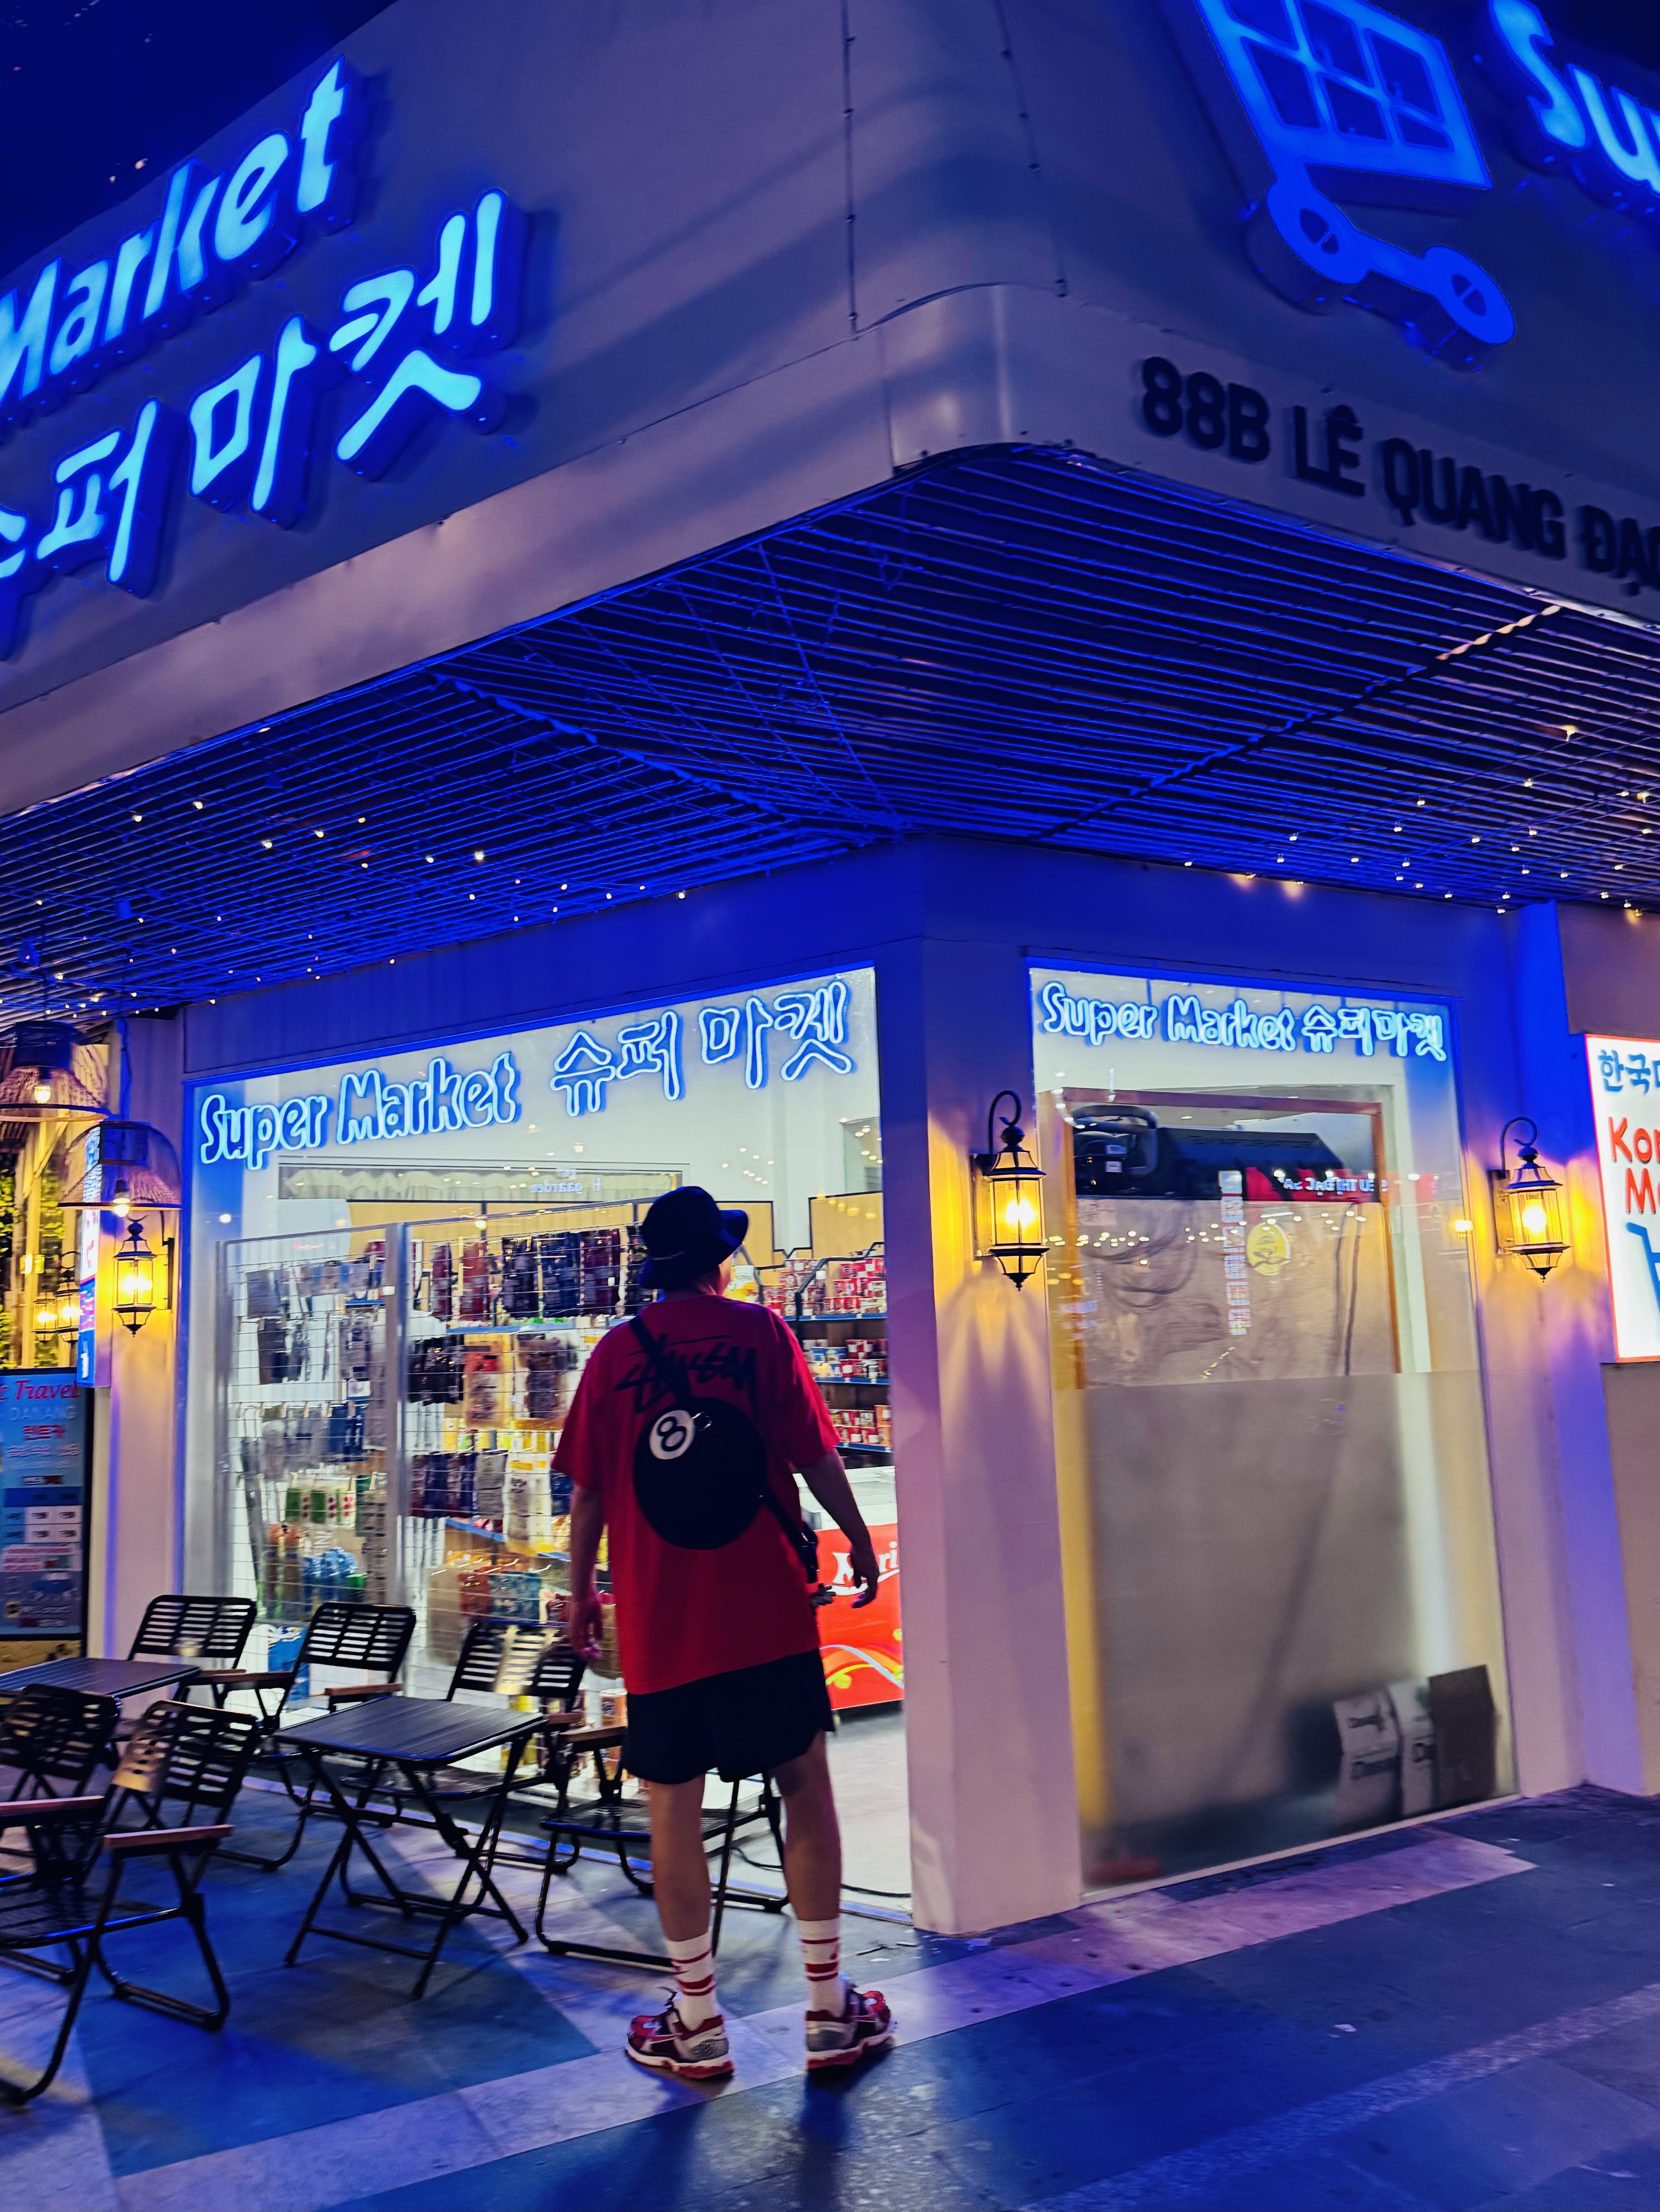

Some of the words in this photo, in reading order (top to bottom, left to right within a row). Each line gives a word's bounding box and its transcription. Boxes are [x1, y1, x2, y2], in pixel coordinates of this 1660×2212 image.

[1489, 0, 1660, 198] Su
[0, 56, 347, 404] Market
[188, 188, 508, 513] 마켓
[1141, 357, 1271, 463] 88B
[1292, 404, 1365, 497] LÊ
[1381, 438, 1566, 559] QUANG
[200, 1094, 328, 1170] Super
[337, 1051, 516, 1145] Market
[550, 1011, 681, 1117] 슈퍼
[698, 981, 853, 1089] 마켓
[1042, 982, 1158, 1046] Super
[1167, 995, 1296, 1051] Market
[15, 1379, 80, 1401] Travel
[656, 1416, 687, 1453] 8
